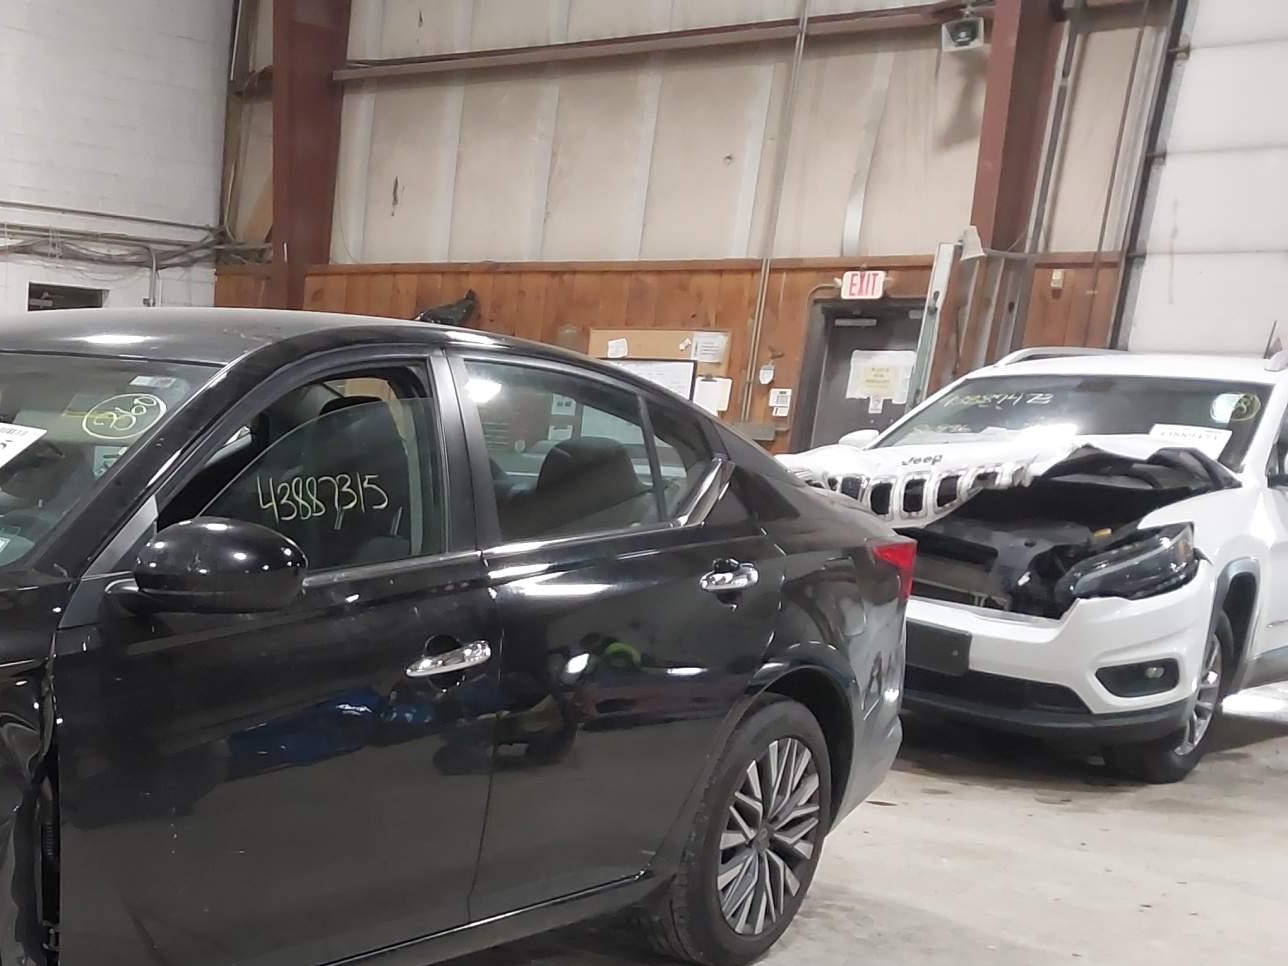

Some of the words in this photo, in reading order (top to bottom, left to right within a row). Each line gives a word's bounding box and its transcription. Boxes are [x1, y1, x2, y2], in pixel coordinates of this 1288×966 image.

[849, 273, 879, 296] EXIT
[901, 454, 943, 466] Jeep
[256, 471, 389, 523] 43887315
